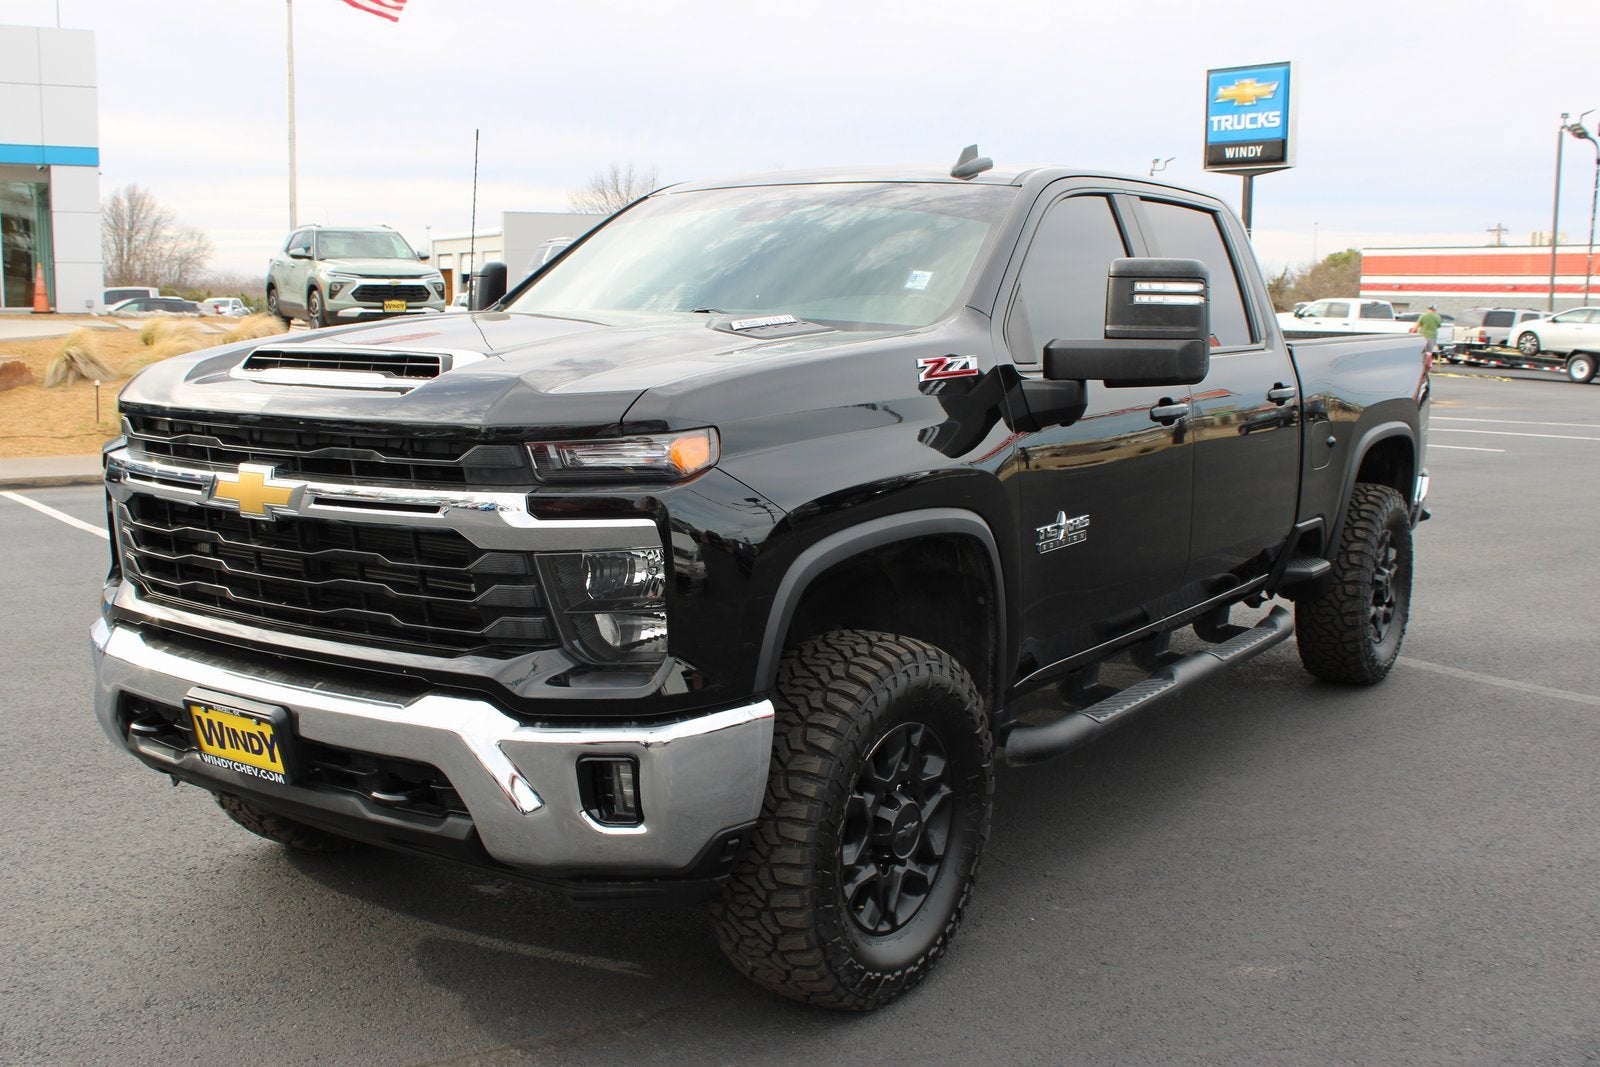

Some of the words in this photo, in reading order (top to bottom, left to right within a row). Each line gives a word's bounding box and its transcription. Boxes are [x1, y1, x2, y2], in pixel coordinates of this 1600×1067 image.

[1210, 111, 1281, 132] TRUCKS
[1225, 145, 1263, 158] WINDY
[917, 355, 978, 382] Z71
[195, 714, 277, 763] WINDY
[202, 753, 285, 784] WINDYCHEV.COM
